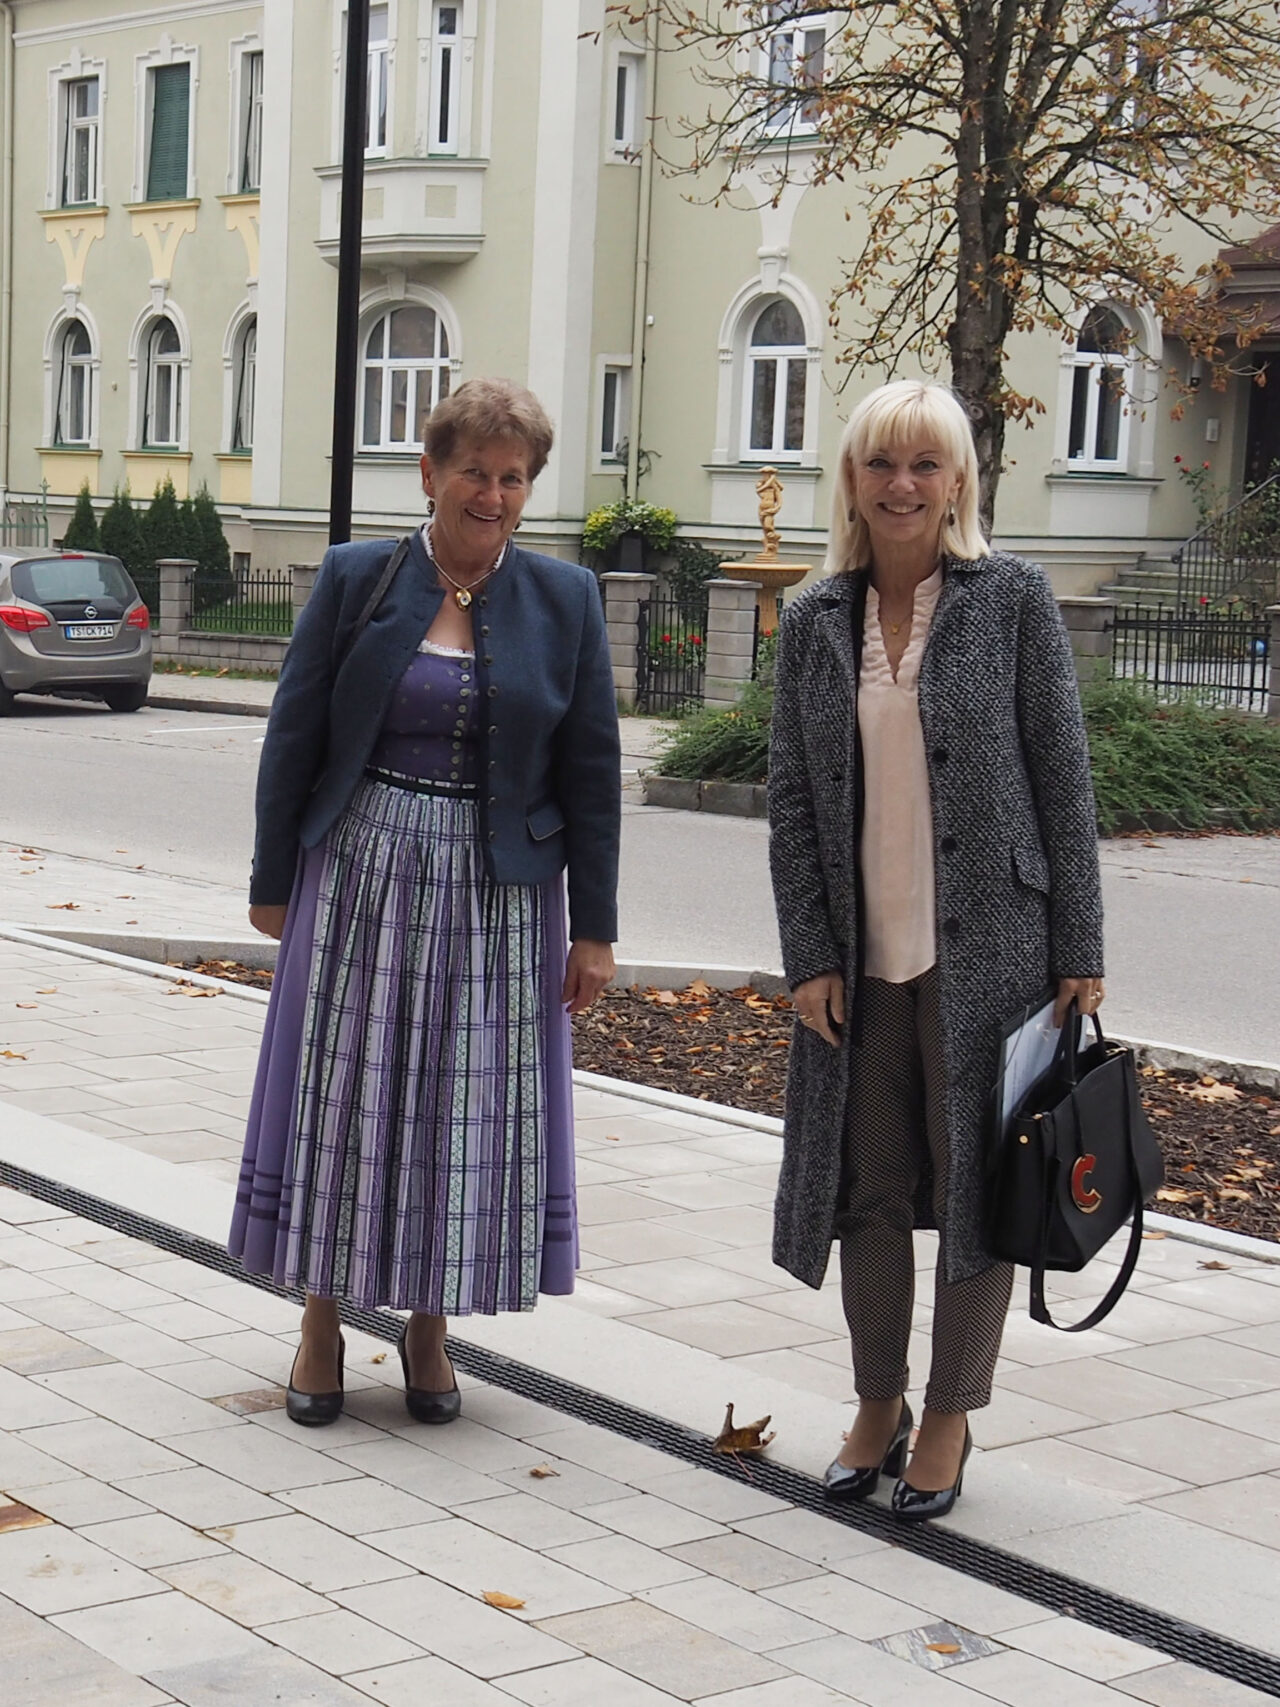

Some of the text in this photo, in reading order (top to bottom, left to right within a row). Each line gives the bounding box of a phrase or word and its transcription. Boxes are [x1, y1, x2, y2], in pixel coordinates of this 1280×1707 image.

[71, 626, 112, 636] TS CK 714
